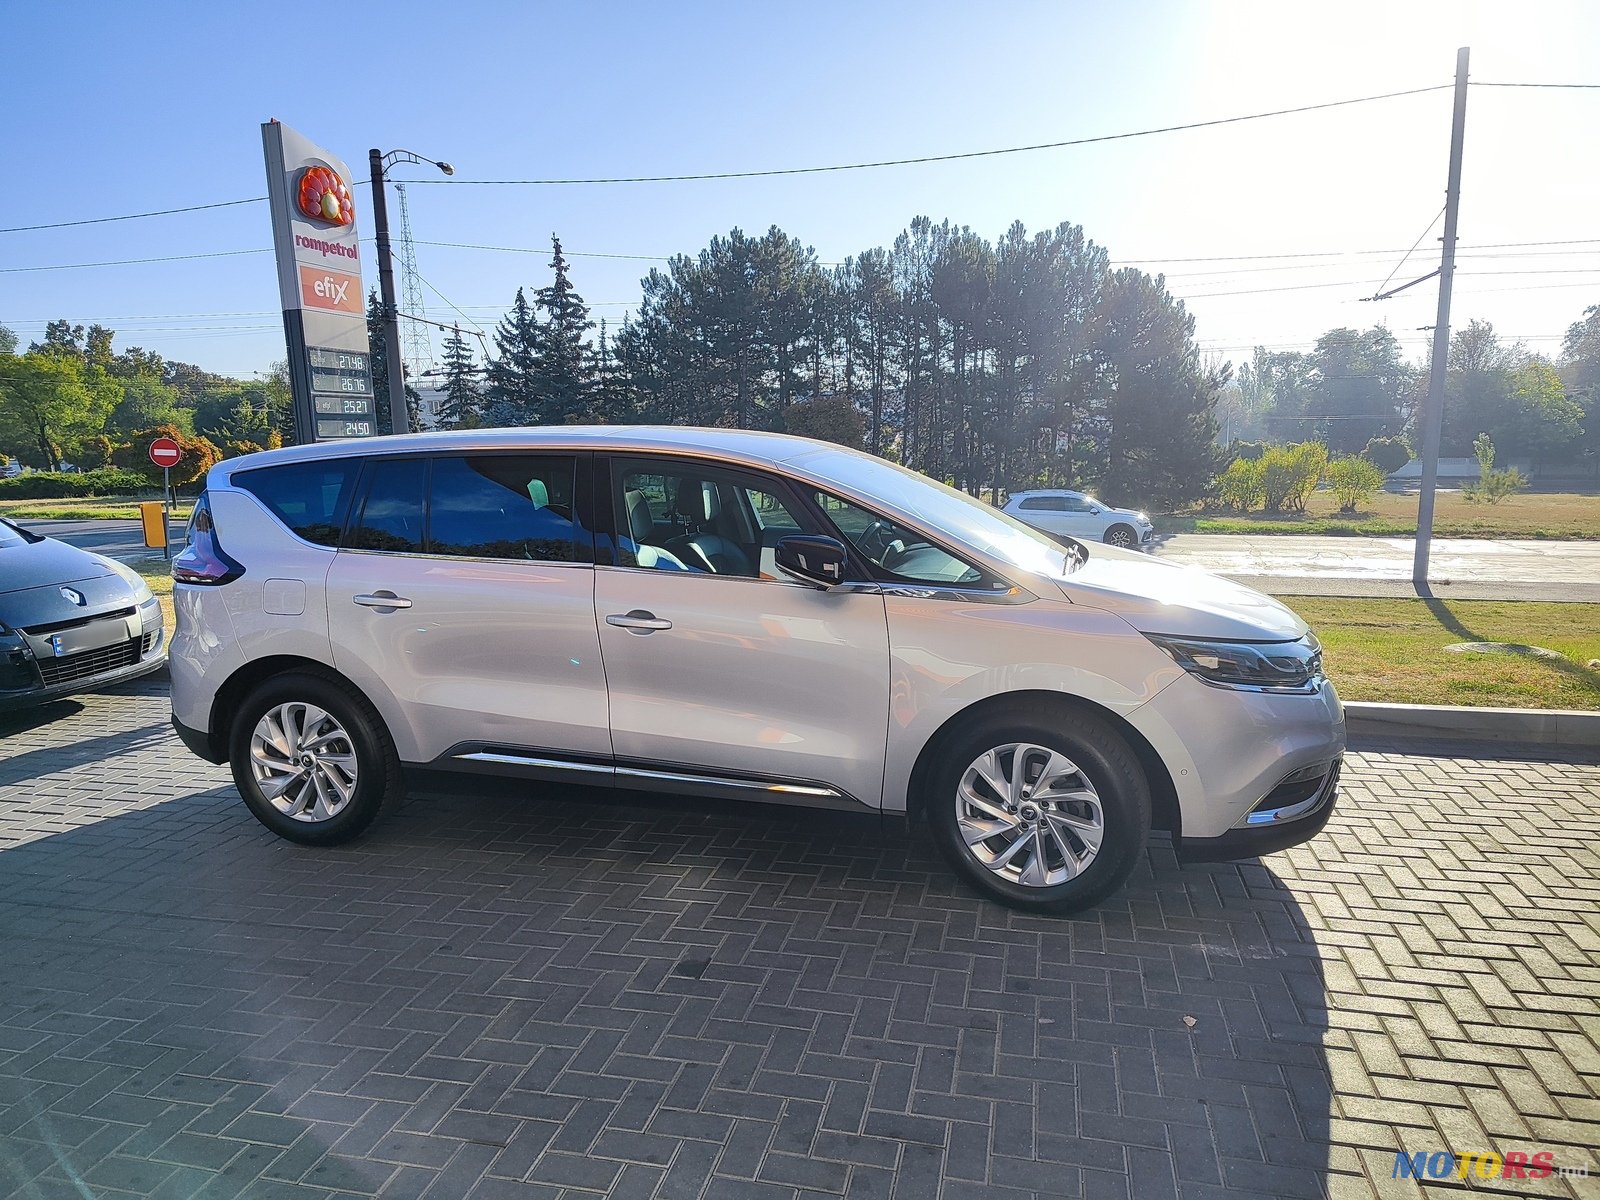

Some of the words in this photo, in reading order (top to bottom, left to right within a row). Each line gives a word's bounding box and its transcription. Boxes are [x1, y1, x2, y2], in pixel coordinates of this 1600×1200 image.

[295, 234, 358, 260] rompetrol
[313, 276, 349, 305] efix
[339, 355, 363, 370] 27.48
[341, 378, 365, 391] 26.76
